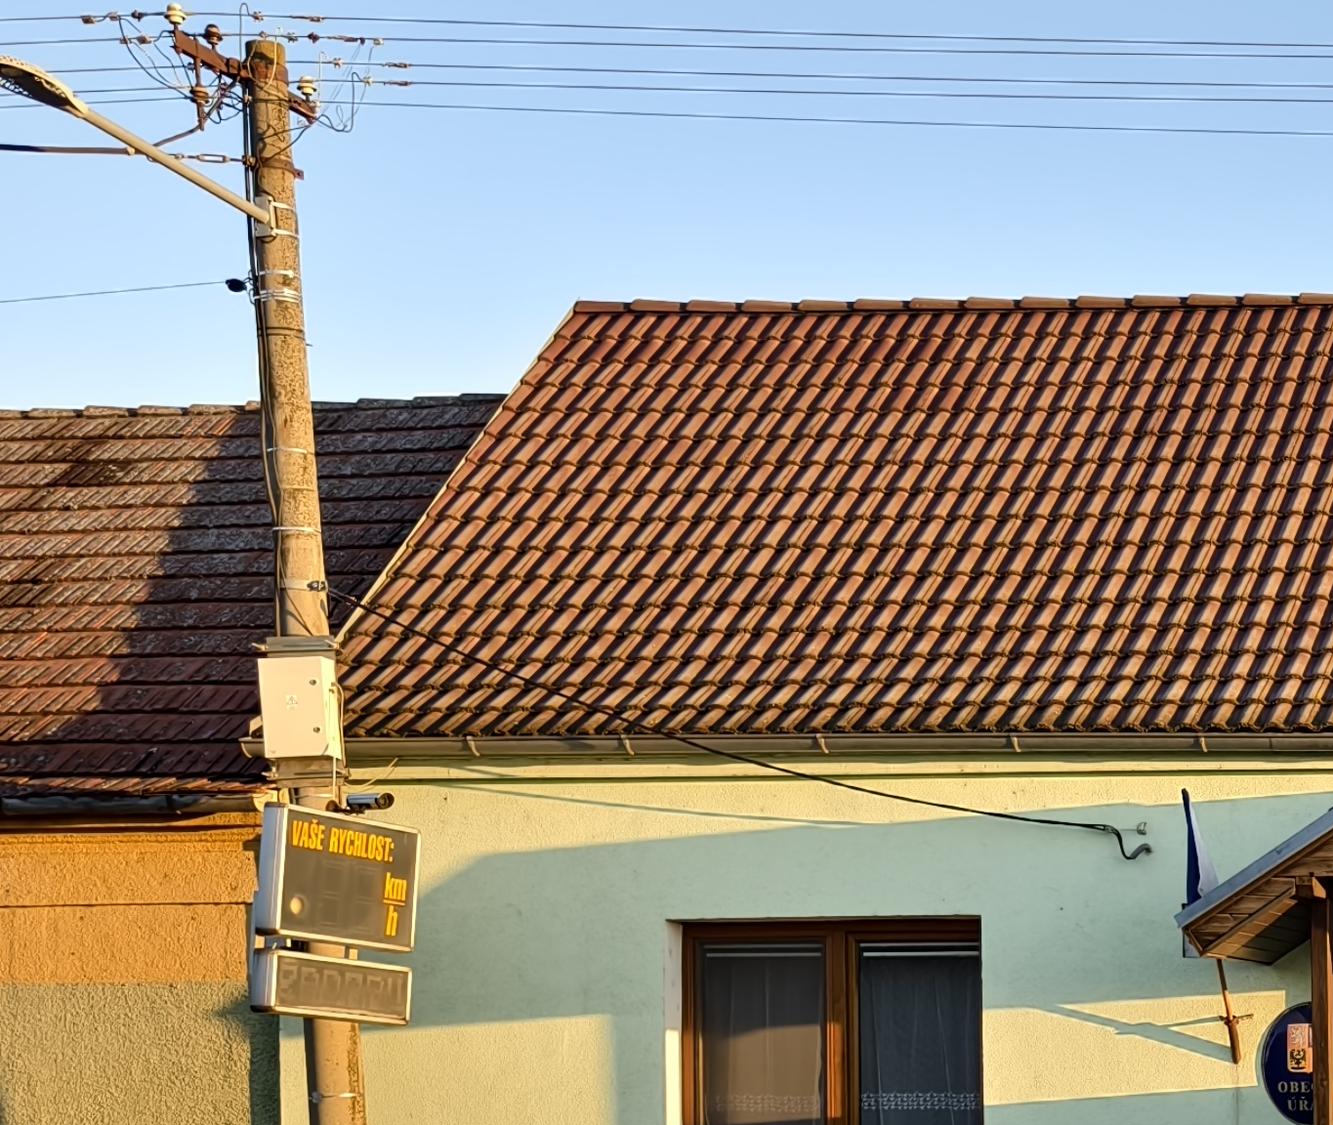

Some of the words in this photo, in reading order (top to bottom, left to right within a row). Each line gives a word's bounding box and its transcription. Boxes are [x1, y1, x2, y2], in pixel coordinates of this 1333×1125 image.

[292, 819, 325, 850] VAŠE
[329, 827, 395, 862] RYCHLOST:
[384, 872, 407, 901] km
[385, 905, 398, 936] h
[1287, 1096, 1314, 1111] ÚŘ
